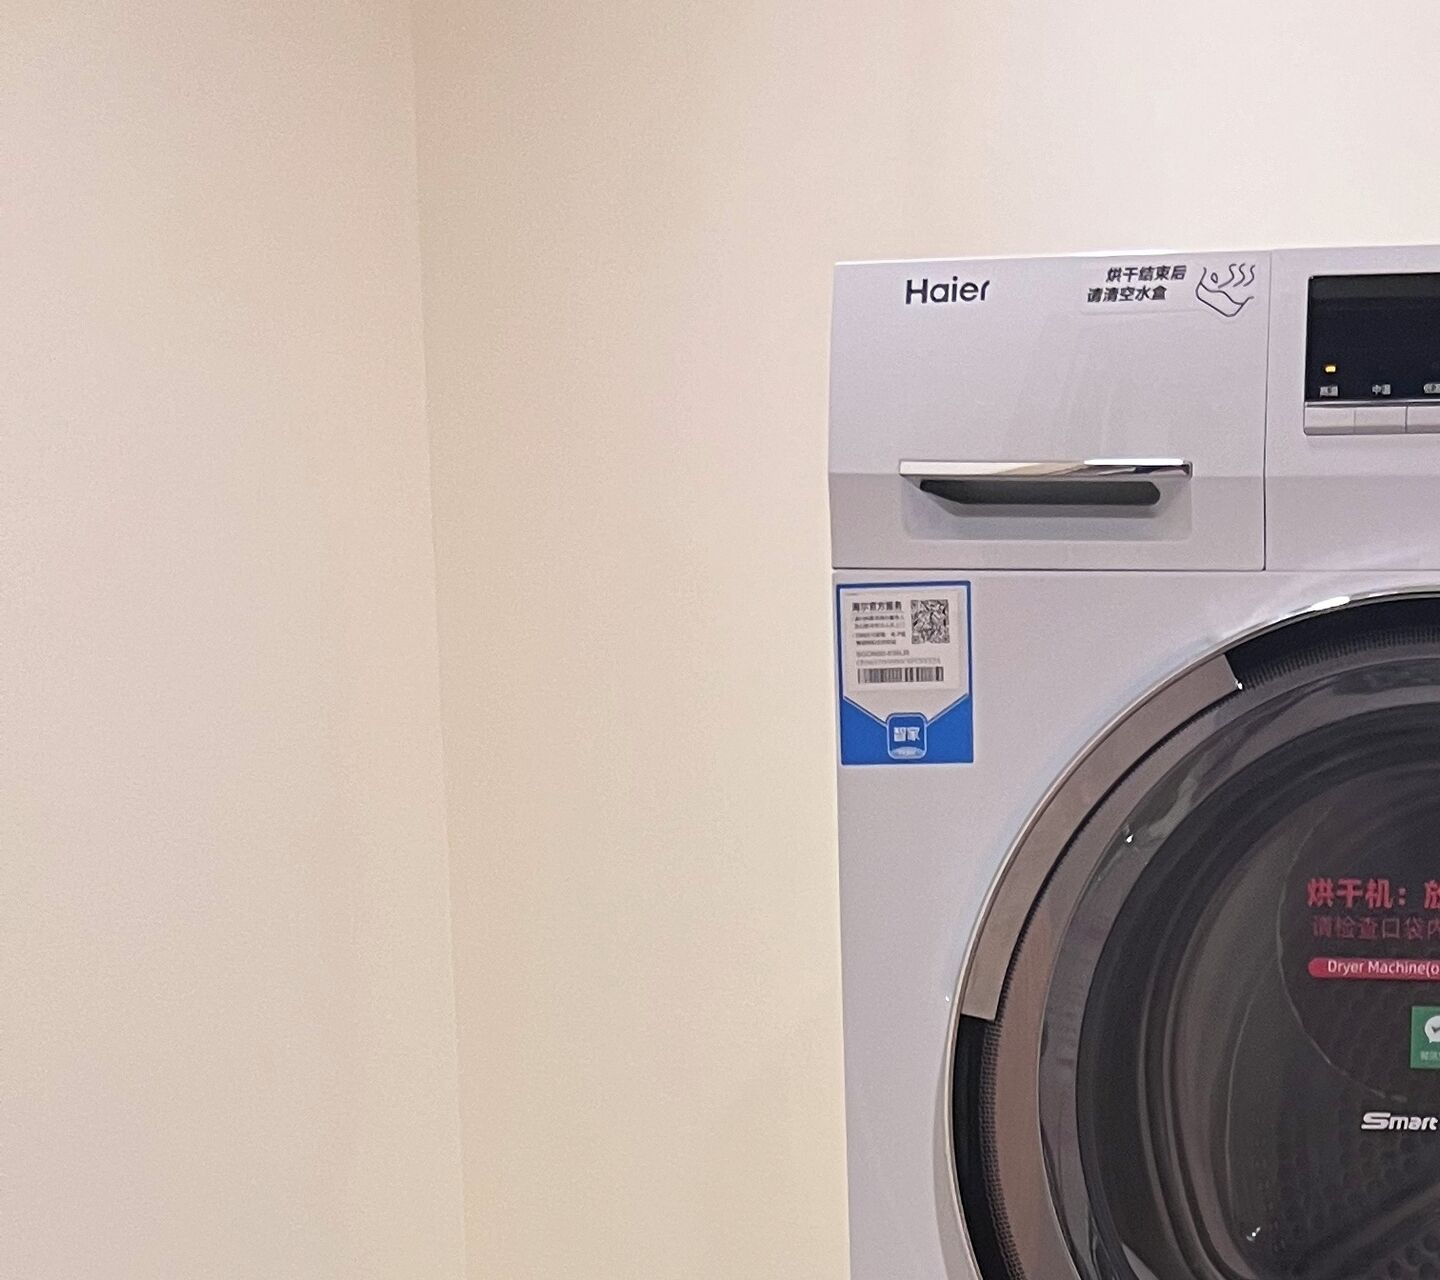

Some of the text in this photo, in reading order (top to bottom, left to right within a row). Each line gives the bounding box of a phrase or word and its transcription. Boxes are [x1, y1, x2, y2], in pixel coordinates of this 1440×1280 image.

[1106, 264, 1188, 283] 烘干结束后
[904, 276, 991, 305] Haier
[1087, 285, 1169, 303] 请清空水盒
[1327, 960, 1364, 976] Dryer
[1361, 1112, 1439, 1131] Smart
